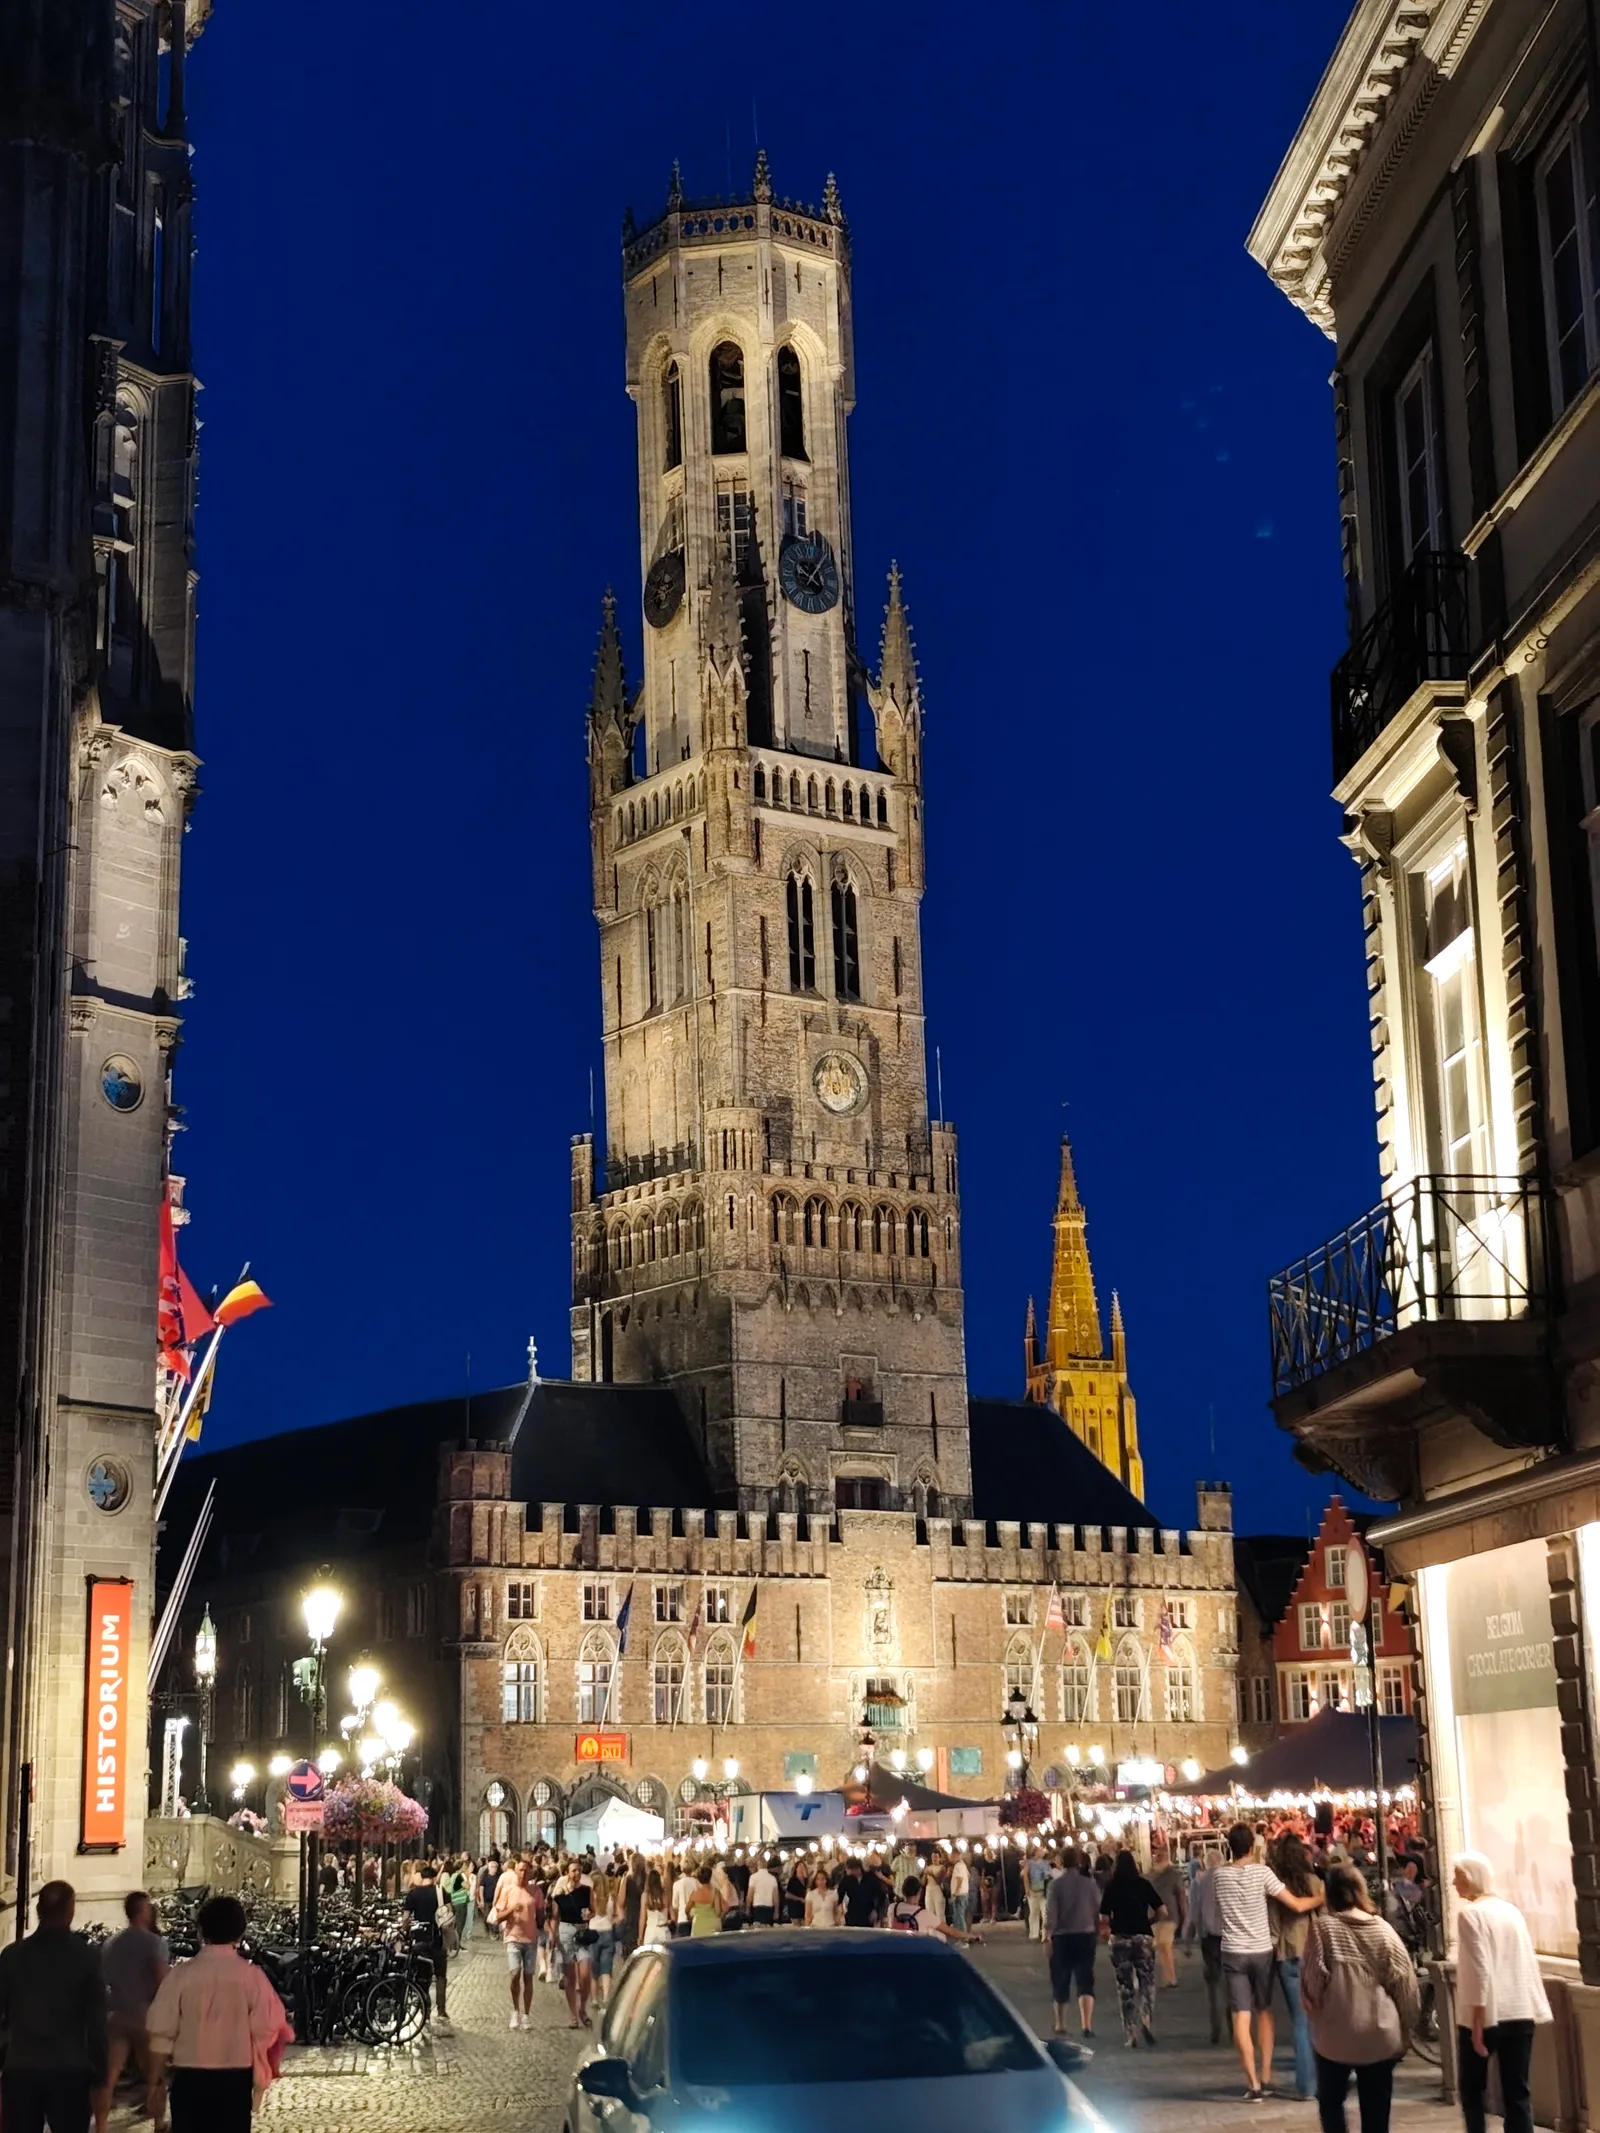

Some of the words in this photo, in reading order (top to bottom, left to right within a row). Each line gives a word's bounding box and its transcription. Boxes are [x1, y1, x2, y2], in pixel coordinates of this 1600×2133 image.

[1485, 1611, 1524, 1639] BELGIUM
[1467, 1648, 1515, 1677] CHOCOLATE
[1515, 1643, 1552, 1670] CORNER
[96, 1614, 122, 1812] HISTORIUM
